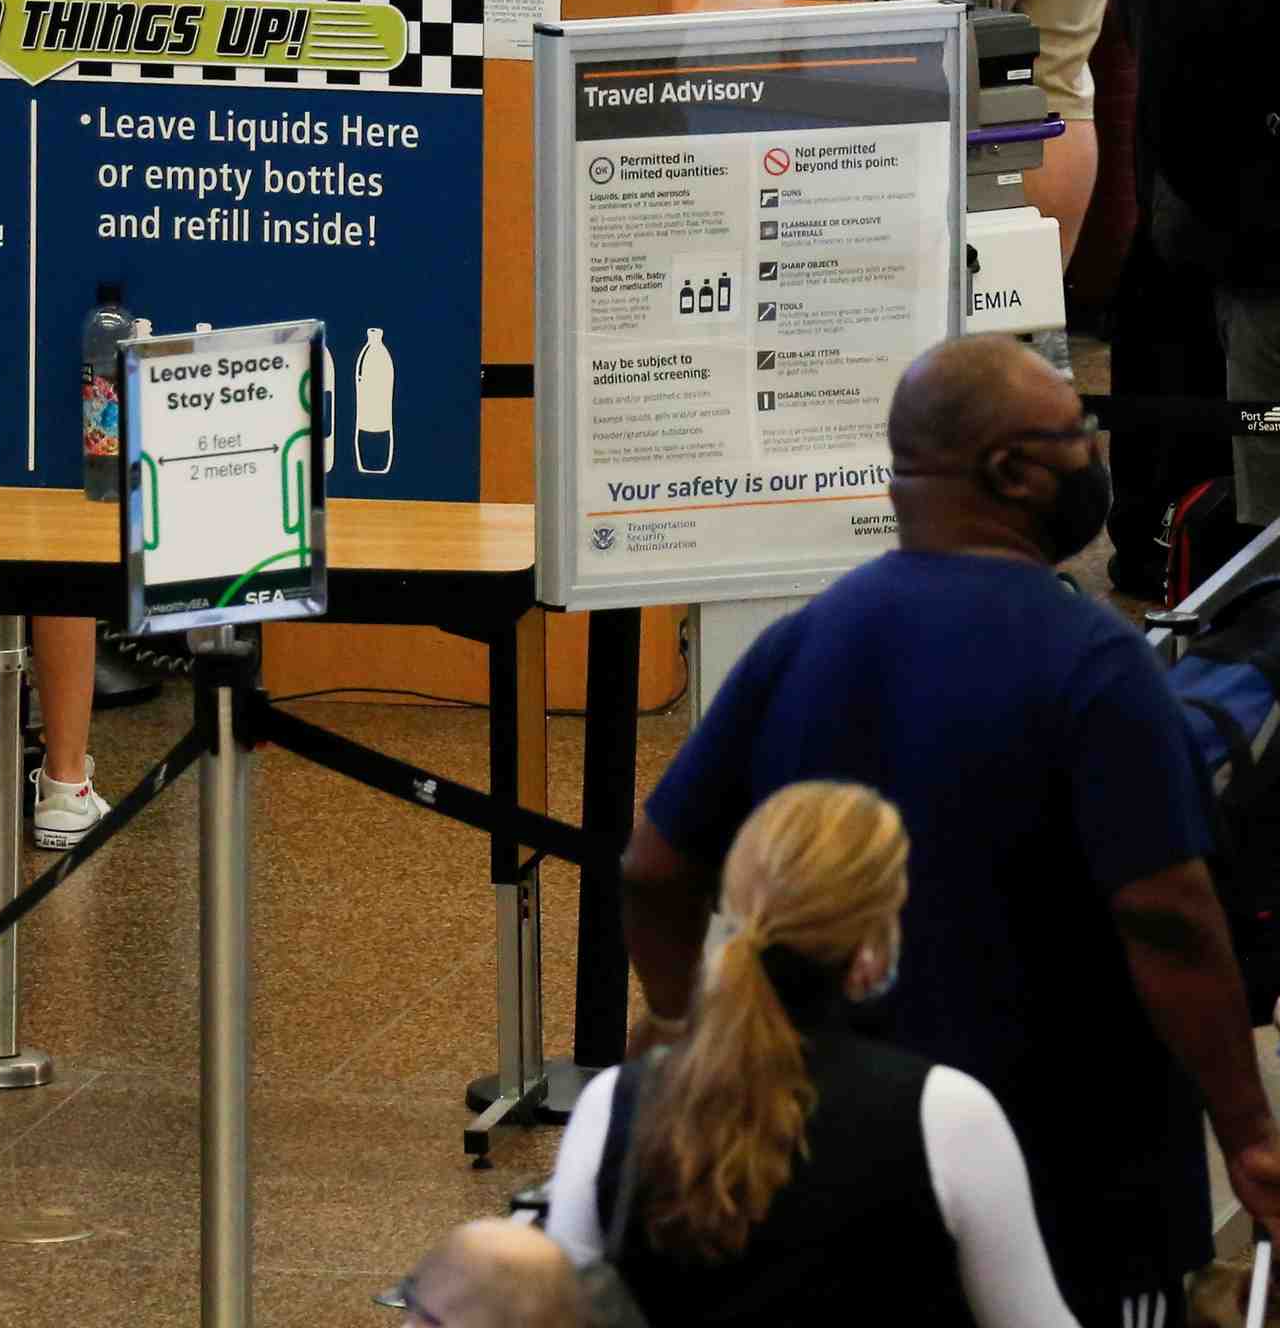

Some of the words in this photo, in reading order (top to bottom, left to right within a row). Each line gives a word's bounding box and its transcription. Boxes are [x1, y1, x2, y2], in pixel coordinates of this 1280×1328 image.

[21, 0, 202, 55] THINGS
[216, 7, 311, 58] UP!
[584, 83, 654, 107] Travel
[660, 79, 764, 104] Advisory
[99, 106, 196, 140] Leave
[209, 110, 329, 151] Liquids
[342, 115, 420, 148] Here
[795, 147, 815, 158] Not
[819, 142, 876, 158] permitted
[620, 153, 680, 167] Permitted
[683, 153, 695, 164] in
[795, 160, 838, 173] beyond
[842, 158, 862, 169] this
[865, 156, 899, 169] point:
[98, 163, 133, 188] or
[145, 164, 252, 200] empty
[265, 160, 383, 197] bottles
[620, 167, 663, 180] limited
[666, 165, 728, 179] quantities:
[98, 206, 160, 239] and
[174, 207, 249, 241] refill
[263, 211, 376, 246] inside!
[841, 217, 881, 226] EXPLOSIVE
[781, 229, 823, 238] MATERIALS
[781, 262, 806, 270] SHARP
[807, 260, 839, 269] OBJECTS
[780, 303, 803, 311] TOOLS
[974, 289, 1022, 311] EMIA
[150, 363, 212, 383] Leave
[217, 355, 289, 378] Space.
[592, 360, 617, 371] May
[620, 358, 634, 368] be
[637, 355, 677, 368] subject
[680, 354, 693, 365] to
[593, 370, 650, 385] additional
[654, 368, 711, 381] screening:
[167, 392, 215, 410] Stay
[220, 383, 273, 404] Safe.
[1241, 411, 1261, 421] Port
[1248, 421, 1257, 431] of
[198, 436, 208, 451] 6
[213, 433, 241, 449] feet
[190, 464, 199, 480] 2
[204, 461, 257, 480] meters
[608, 482, 660, 502] Your
[667, 475, 738, 498] safety
[745, 473, 763, 493] is
[770, 473, 808, 492] our
[627, 520, 696, 532] Transportation
[851, 516, 880, 525] Learn
[626, 531, 665, 543] Security
[626, 541, 697, 553] Administration
[245, 589, 285, 605] SEA
